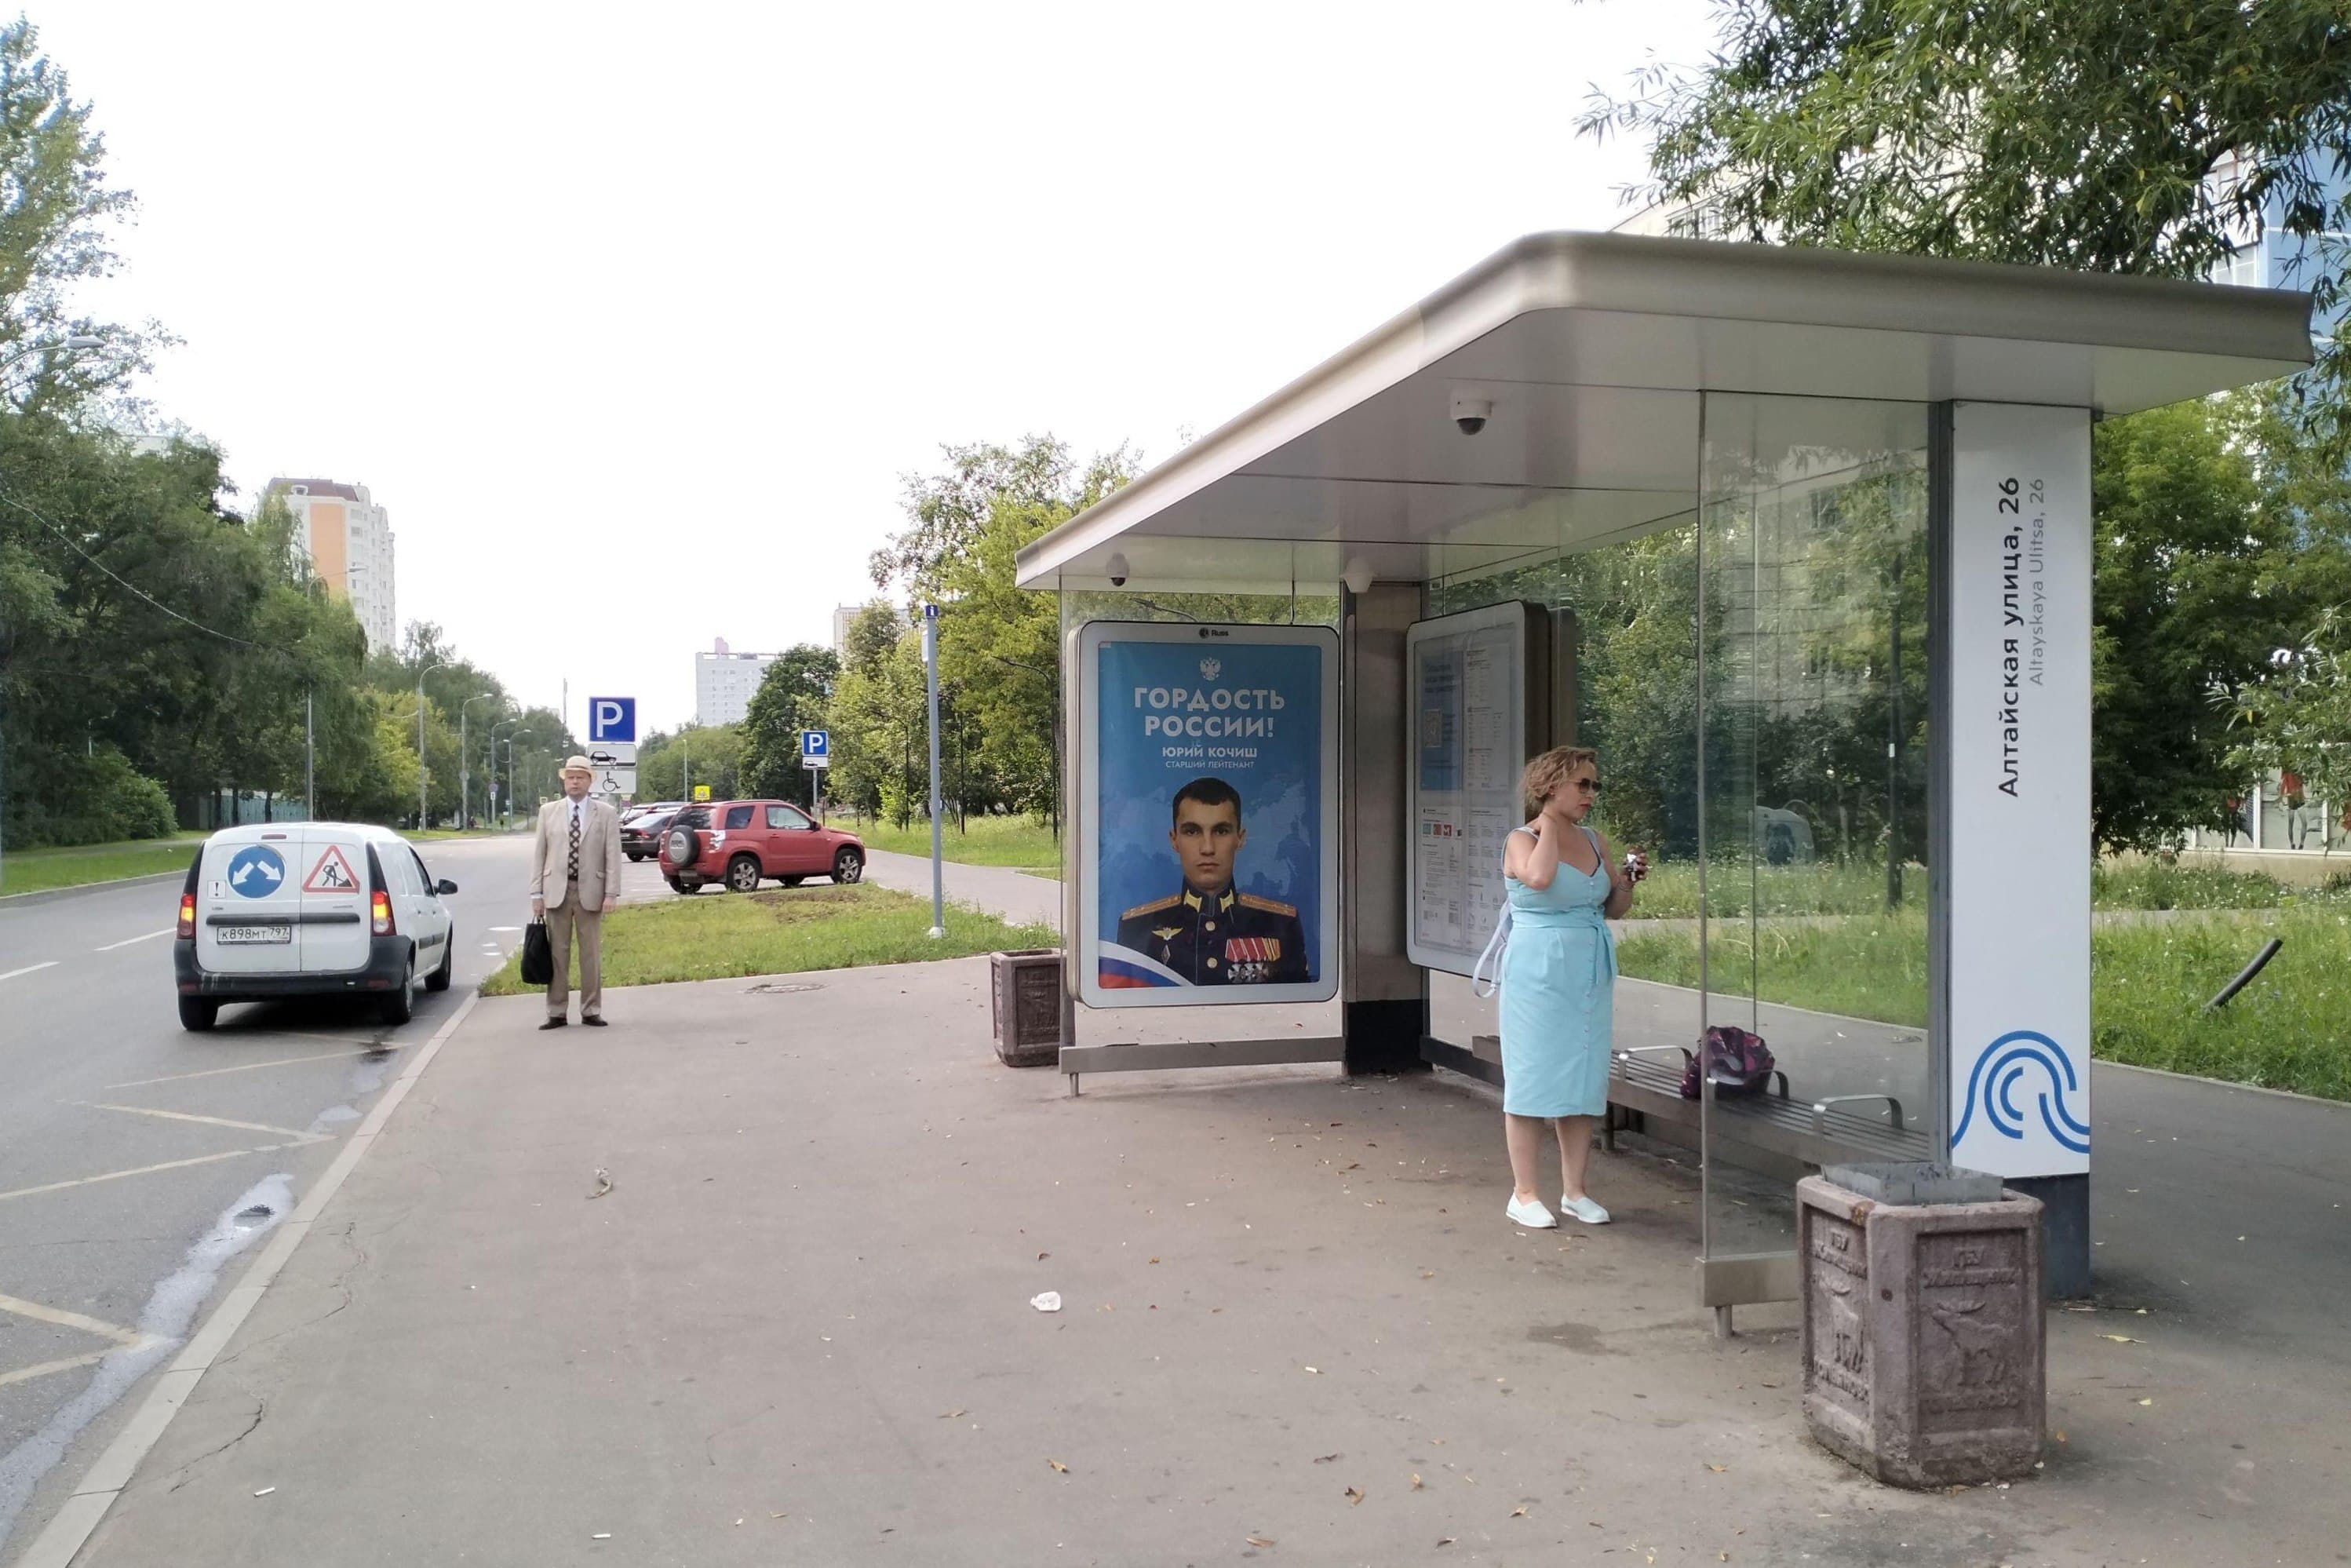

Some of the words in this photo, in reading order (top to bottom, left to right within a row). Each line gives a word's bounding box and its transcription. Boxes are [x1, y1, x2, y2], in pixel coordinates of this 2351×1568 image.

[1998, 476, 2020, 515] 26
[2028, 478, 2045, 505] 26
[2028, 512, 2047, 574] Ulitsa,
[2003, 526, 2025, 627] улица,
[2028, 580, 2047, 687] Altayskaya
[1134, 687, 1285, 713] ГОРДОСТЬ
[596, 701, 624, 738] P
[1144, 714, 1274, 738] РОССИИ!
[1998, 638, 2020, 798] Алтайская
[809, 734, 823, 753] P
[1161, 744, 1204, 758] ЮРИЙ
[1208, 746, 1258, 758] КОЧИШ
[1165, 760, 1206, 768] СТАРШИЙ
[1208, 760, 1256, 769] ЛЕЙТЕНАНТ
[221, 928, 267, 940] К898МТ
[270, 928, 287, 936] 797
